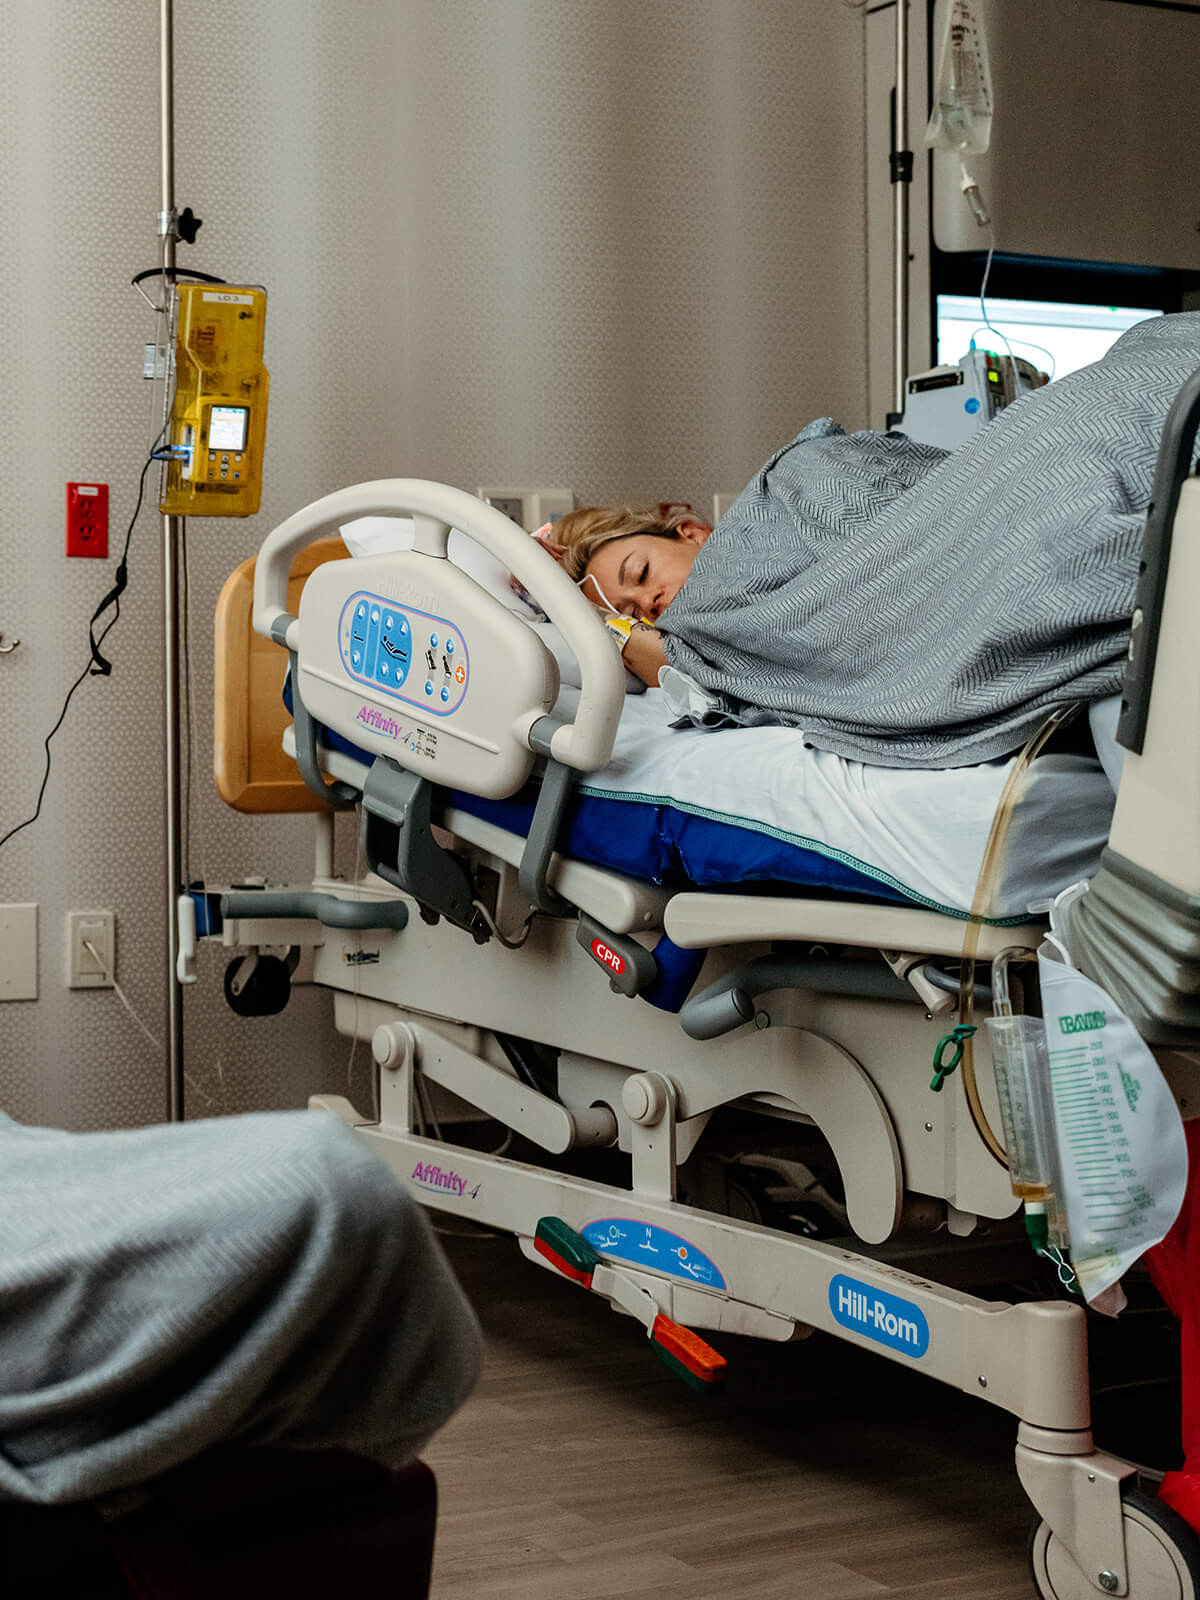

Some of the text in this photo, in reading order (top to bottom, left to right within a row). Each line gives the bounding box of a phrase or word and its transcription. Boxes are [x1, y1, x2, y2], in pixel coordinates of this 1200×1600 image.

[356, 705, 403, 740] Affinity
[597, 944, 621, 970] CPR
[411, 1161, 468, 1196] Affinity
[838, 1285, 918, 1345] Hill-Rom
